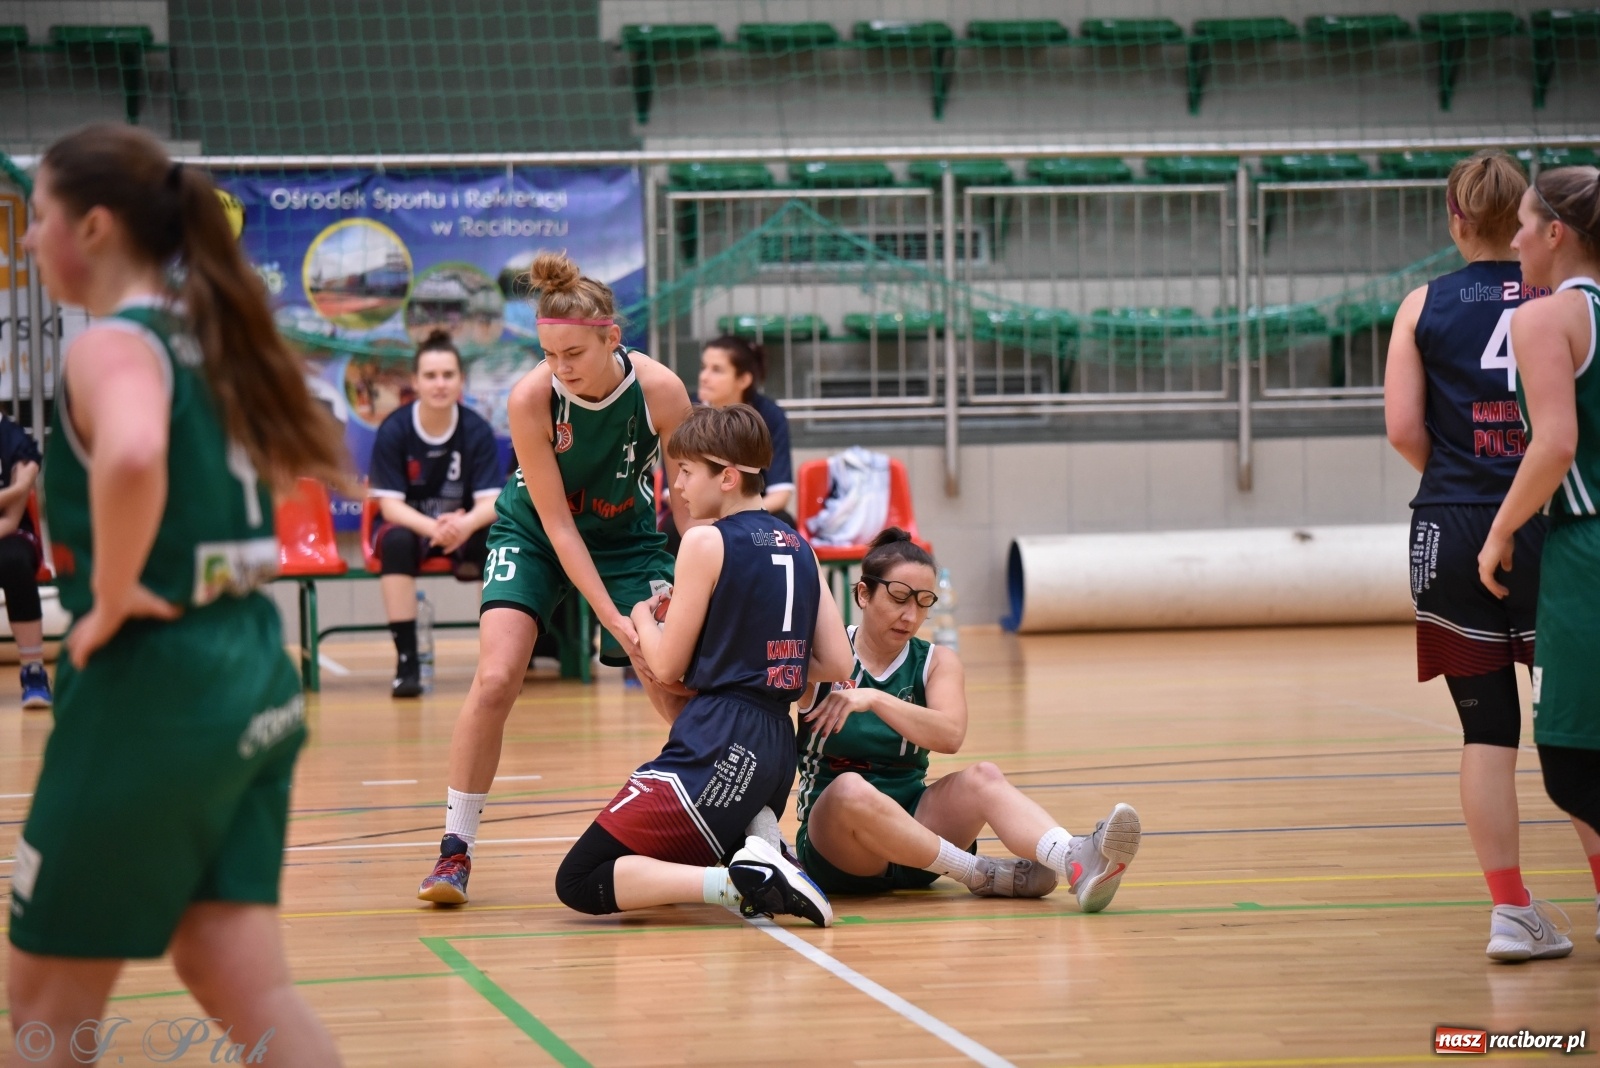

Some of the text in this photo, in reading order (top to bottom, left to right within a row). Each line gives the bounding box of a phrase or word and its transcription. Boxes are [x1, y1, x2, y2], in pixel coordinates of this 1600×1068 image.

[372, 187, 446, 213] Sportu
[452, 188, 459, 209] i
[430, 220, 453, 236] w
[1480, 307, 1518, 391] 4
[447, 451, 461, 481] 3
[1430, 531, 1440, 569] PASSION
[482, 547, 520, 589] 35
[771, 554, 794, 631] 7
[739, 760, 757, 794] PASSION
[610, 786, 640, 813] 7
